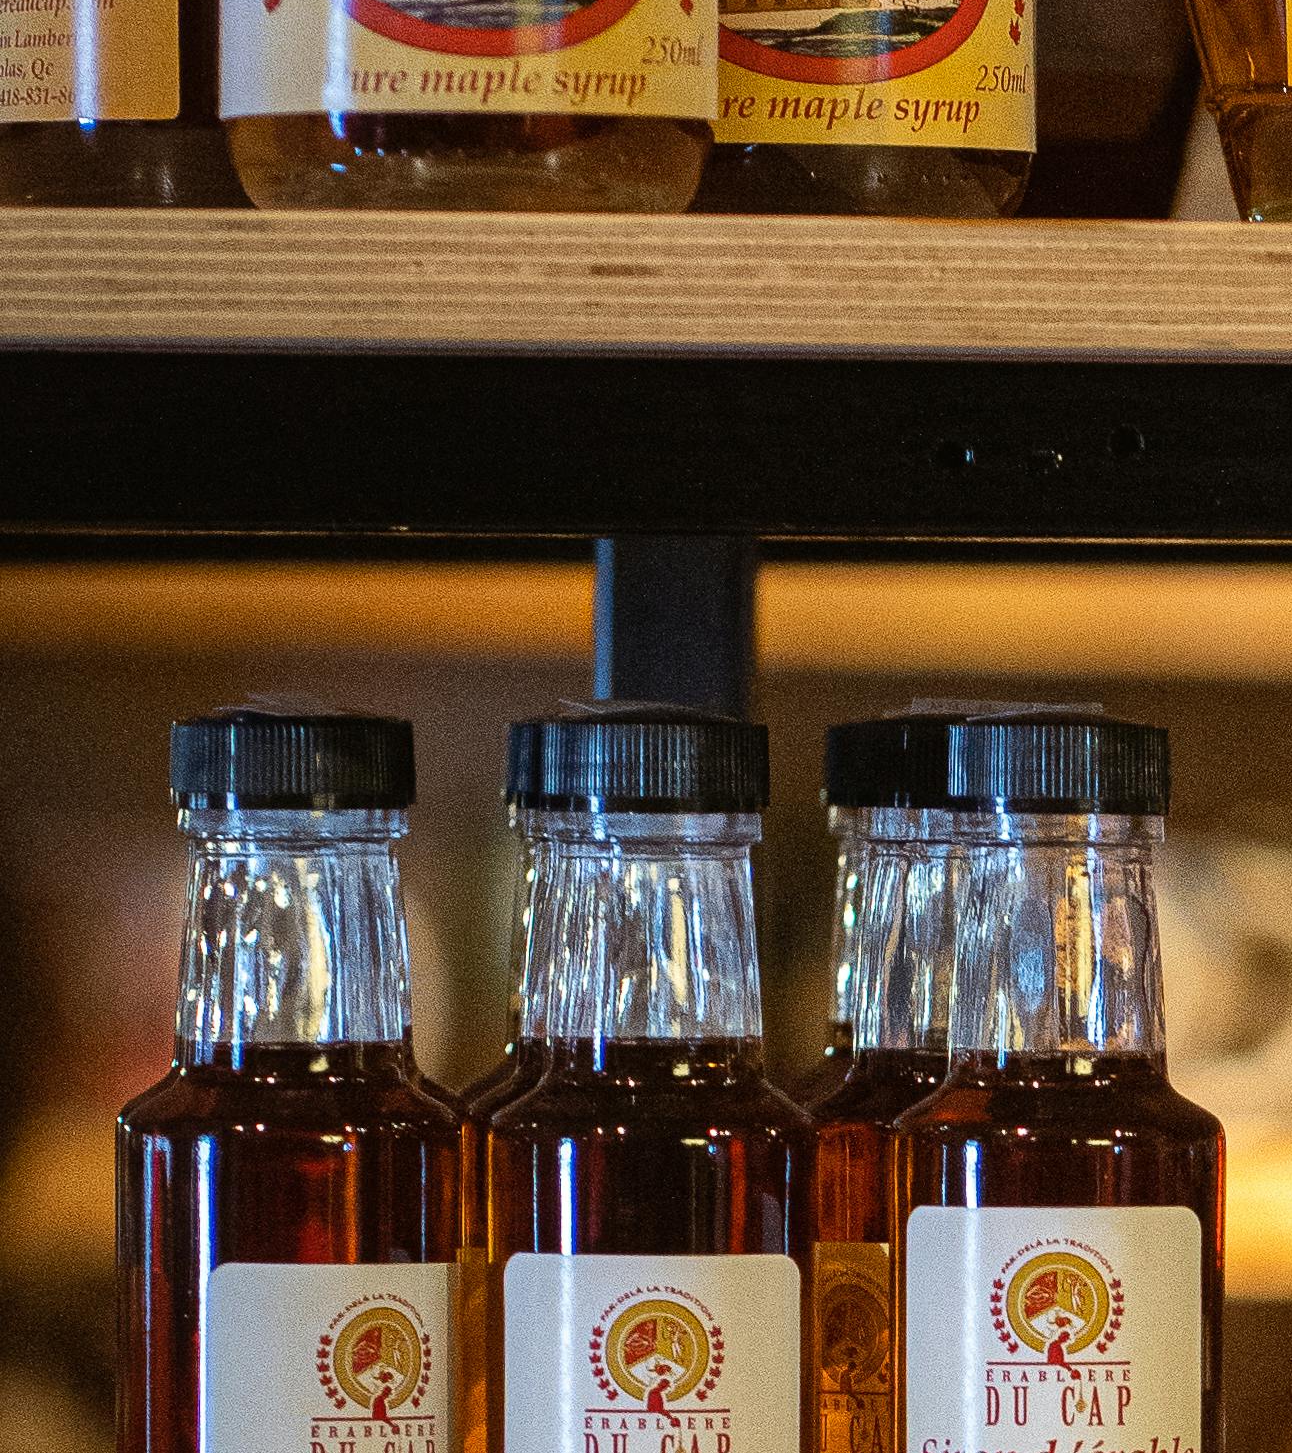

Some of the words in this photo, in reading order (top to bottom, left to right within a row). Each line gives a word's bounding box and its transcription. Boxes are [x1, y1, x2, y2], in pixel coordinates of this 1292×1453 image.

[640, 35, 701, 66] 250ml
[419, 63, 542, 109] maple
[553, 70, 646, 104] syrup
[976, 66, 1028, 95] 250ml
[769, 88, 883, 133] maple
[893, 98, 981, 132] syrup
[985, 1386, 1029, 1426] DU
[1061, 1386, 1132, 1427] CAP
